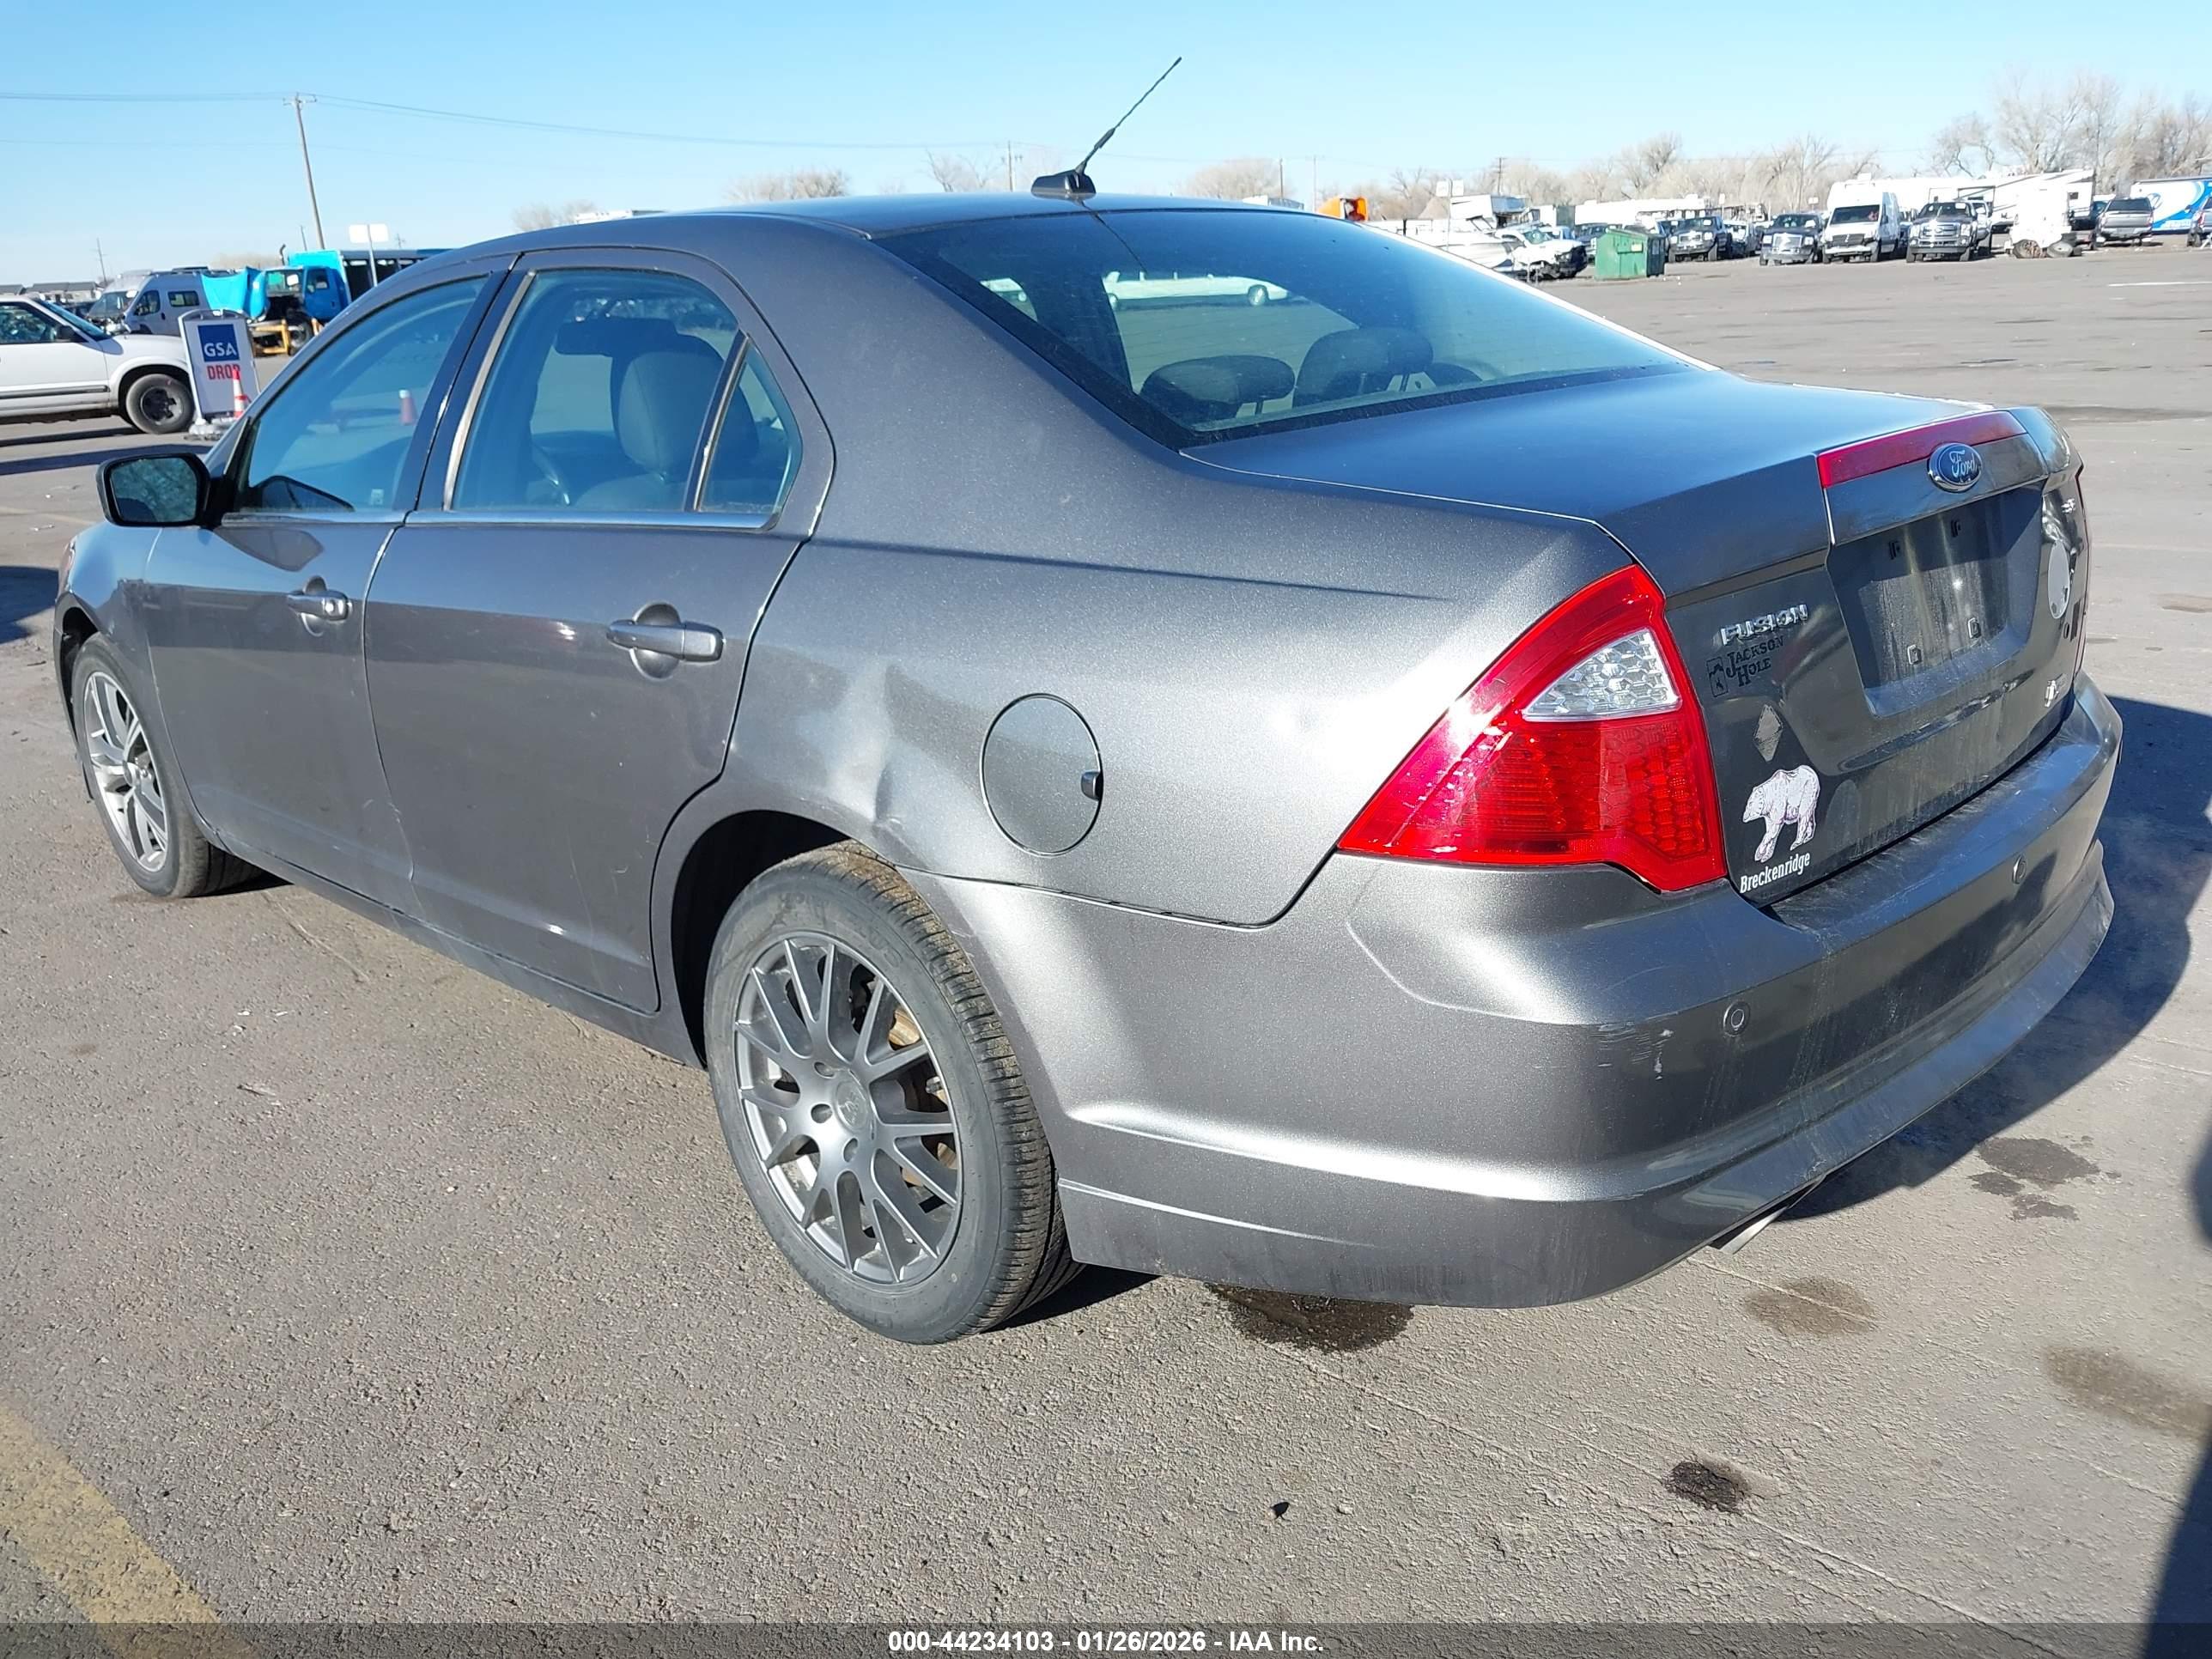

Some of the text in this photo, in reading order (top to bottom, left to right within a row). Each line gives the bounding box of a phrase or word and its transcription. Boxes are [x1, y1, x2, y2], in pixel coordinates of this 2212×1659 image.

[204, 342, 237, 357] GSA
[1949, 450, 1978, 478] Ford
[1721, 604, 1808, 646] FUSION
[1739, 852, 1811, 894] Breckenridge
